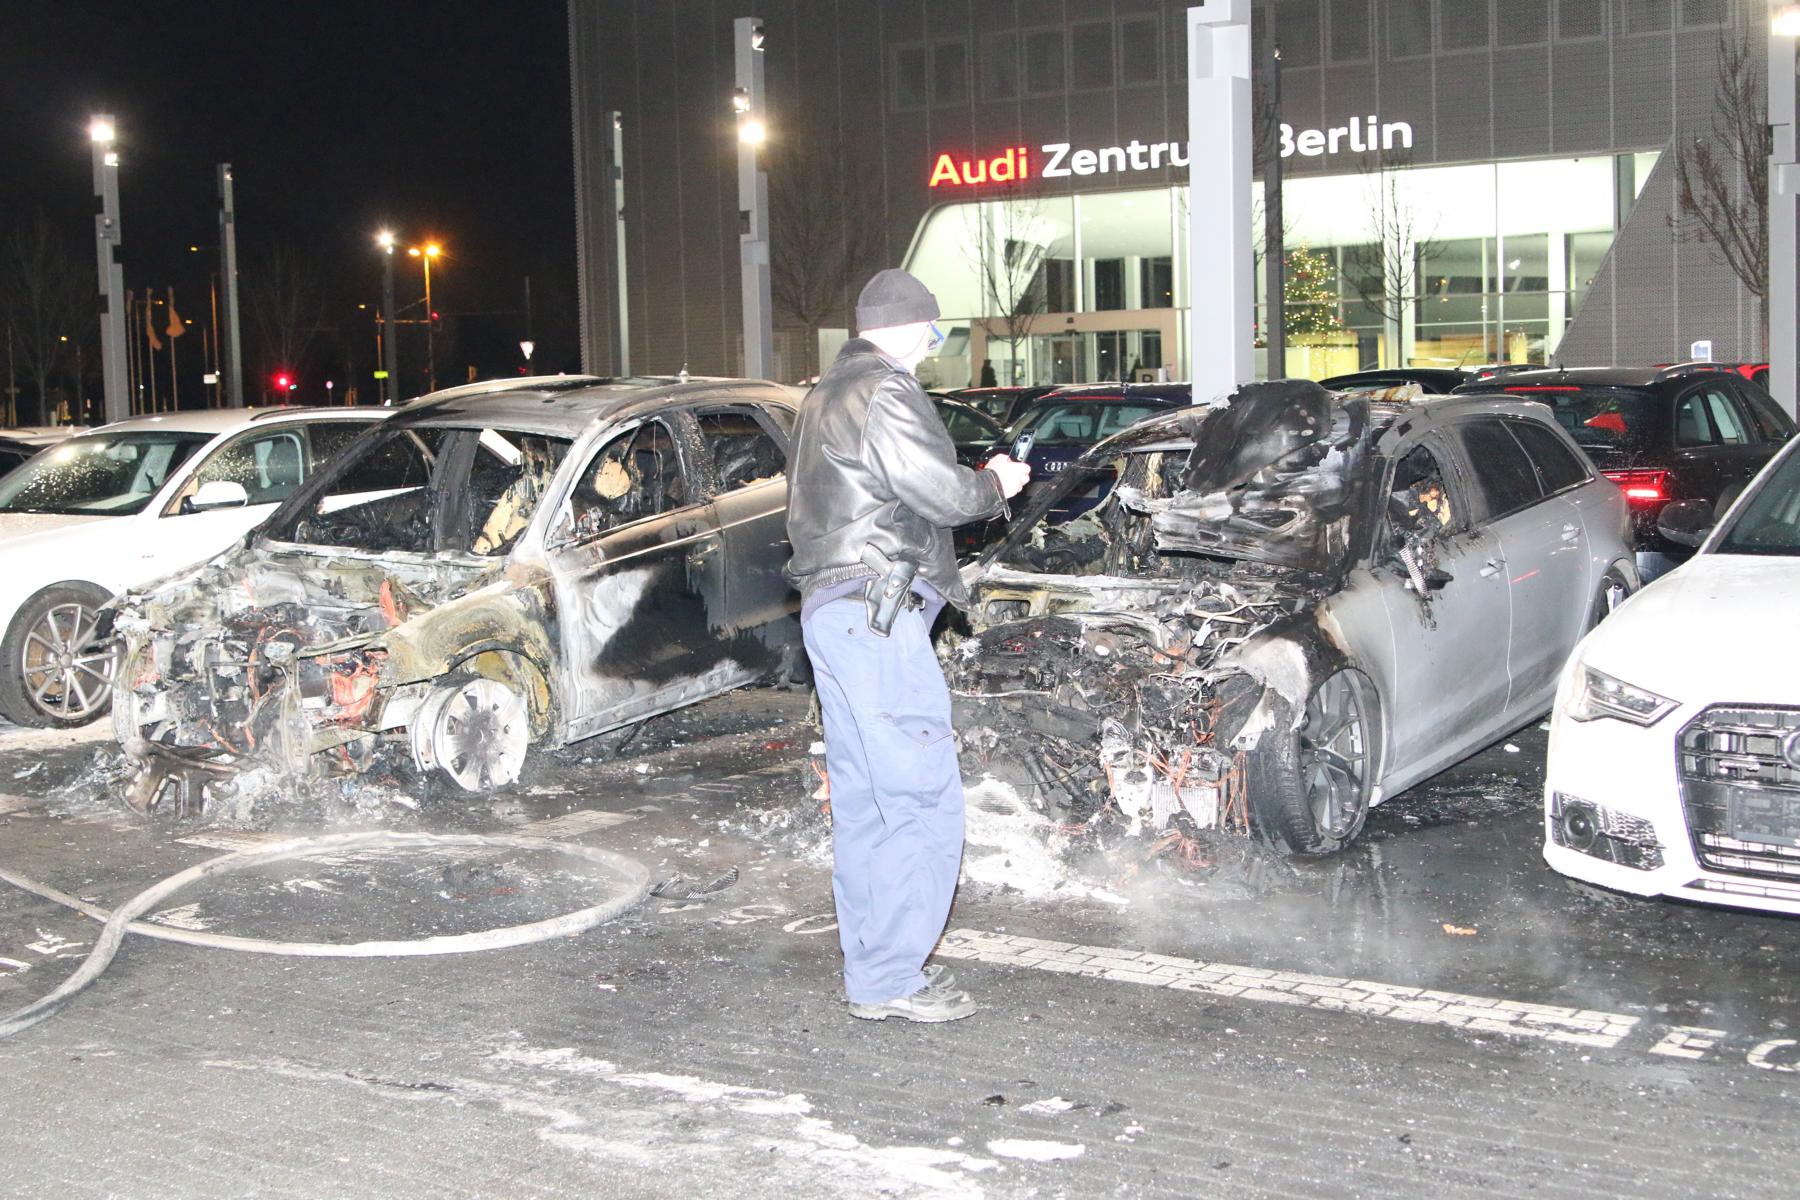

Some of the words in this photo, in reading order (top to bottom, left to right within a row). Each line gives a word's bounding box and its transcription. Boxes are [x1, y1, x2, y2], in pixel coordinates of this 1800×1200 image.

[929, 147, 1028, 187] Audi
[1041, 140, 1190, 178] Zentru
[1279, 115, 1413, 158] Berlin
